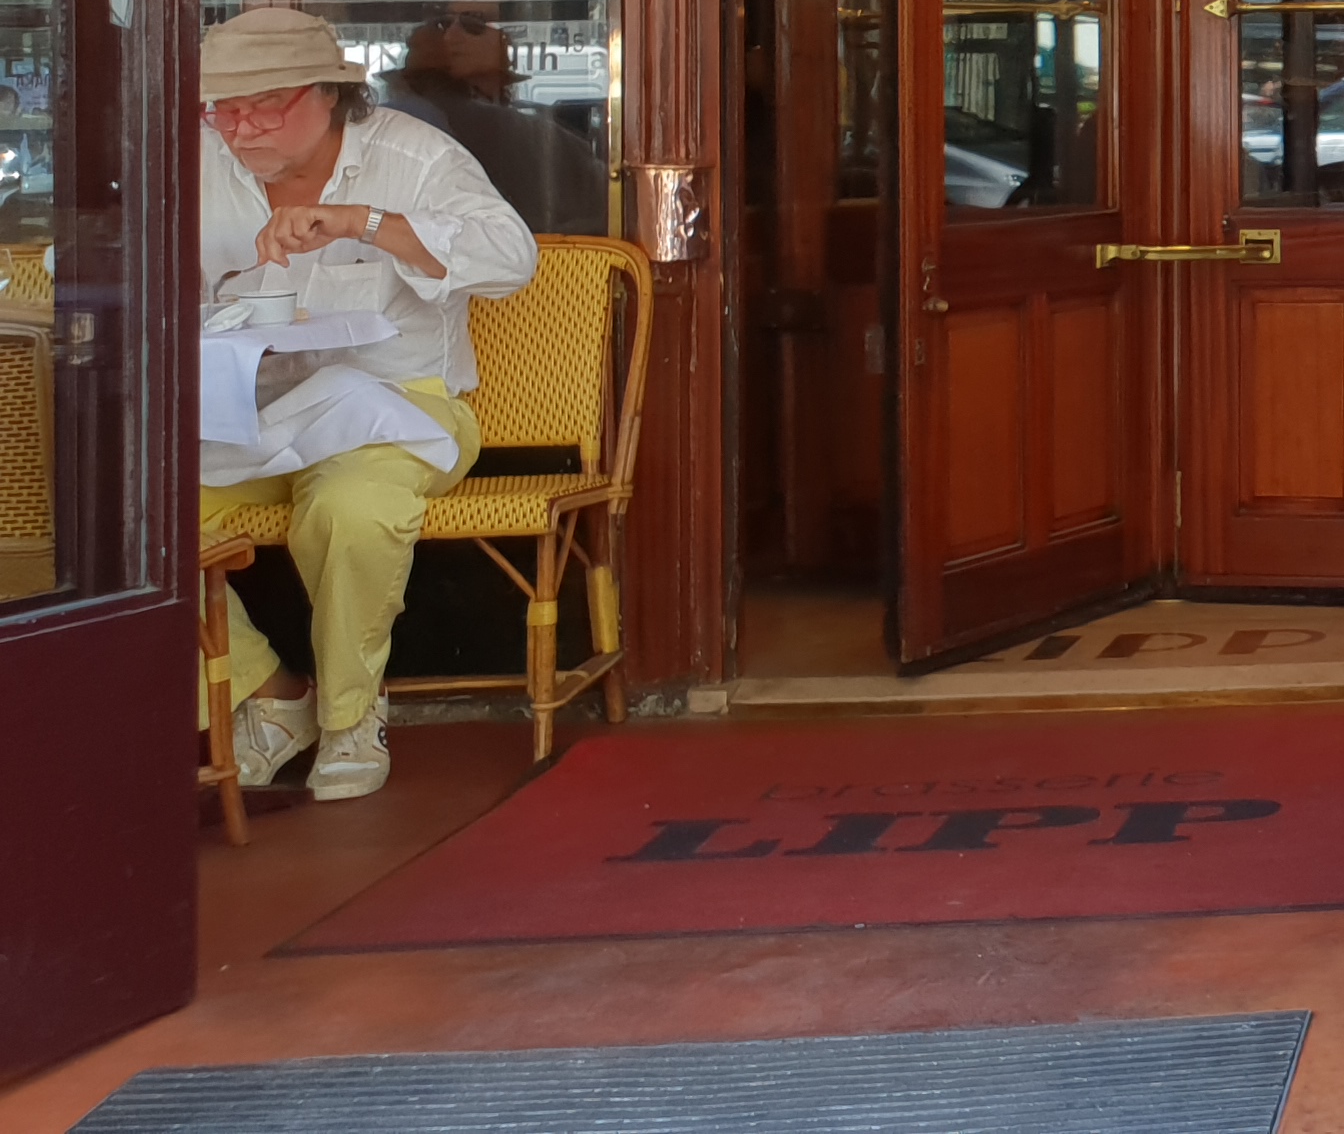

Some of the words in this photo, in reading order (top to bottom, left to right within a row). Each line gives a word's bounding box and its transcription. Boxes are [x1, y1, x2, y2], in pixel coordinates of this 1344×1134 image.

[970, 628, 1326, 663] IPP
[761, 766, 1225, 802] brasserie
[605, 798, 1282, 864] LIPP
